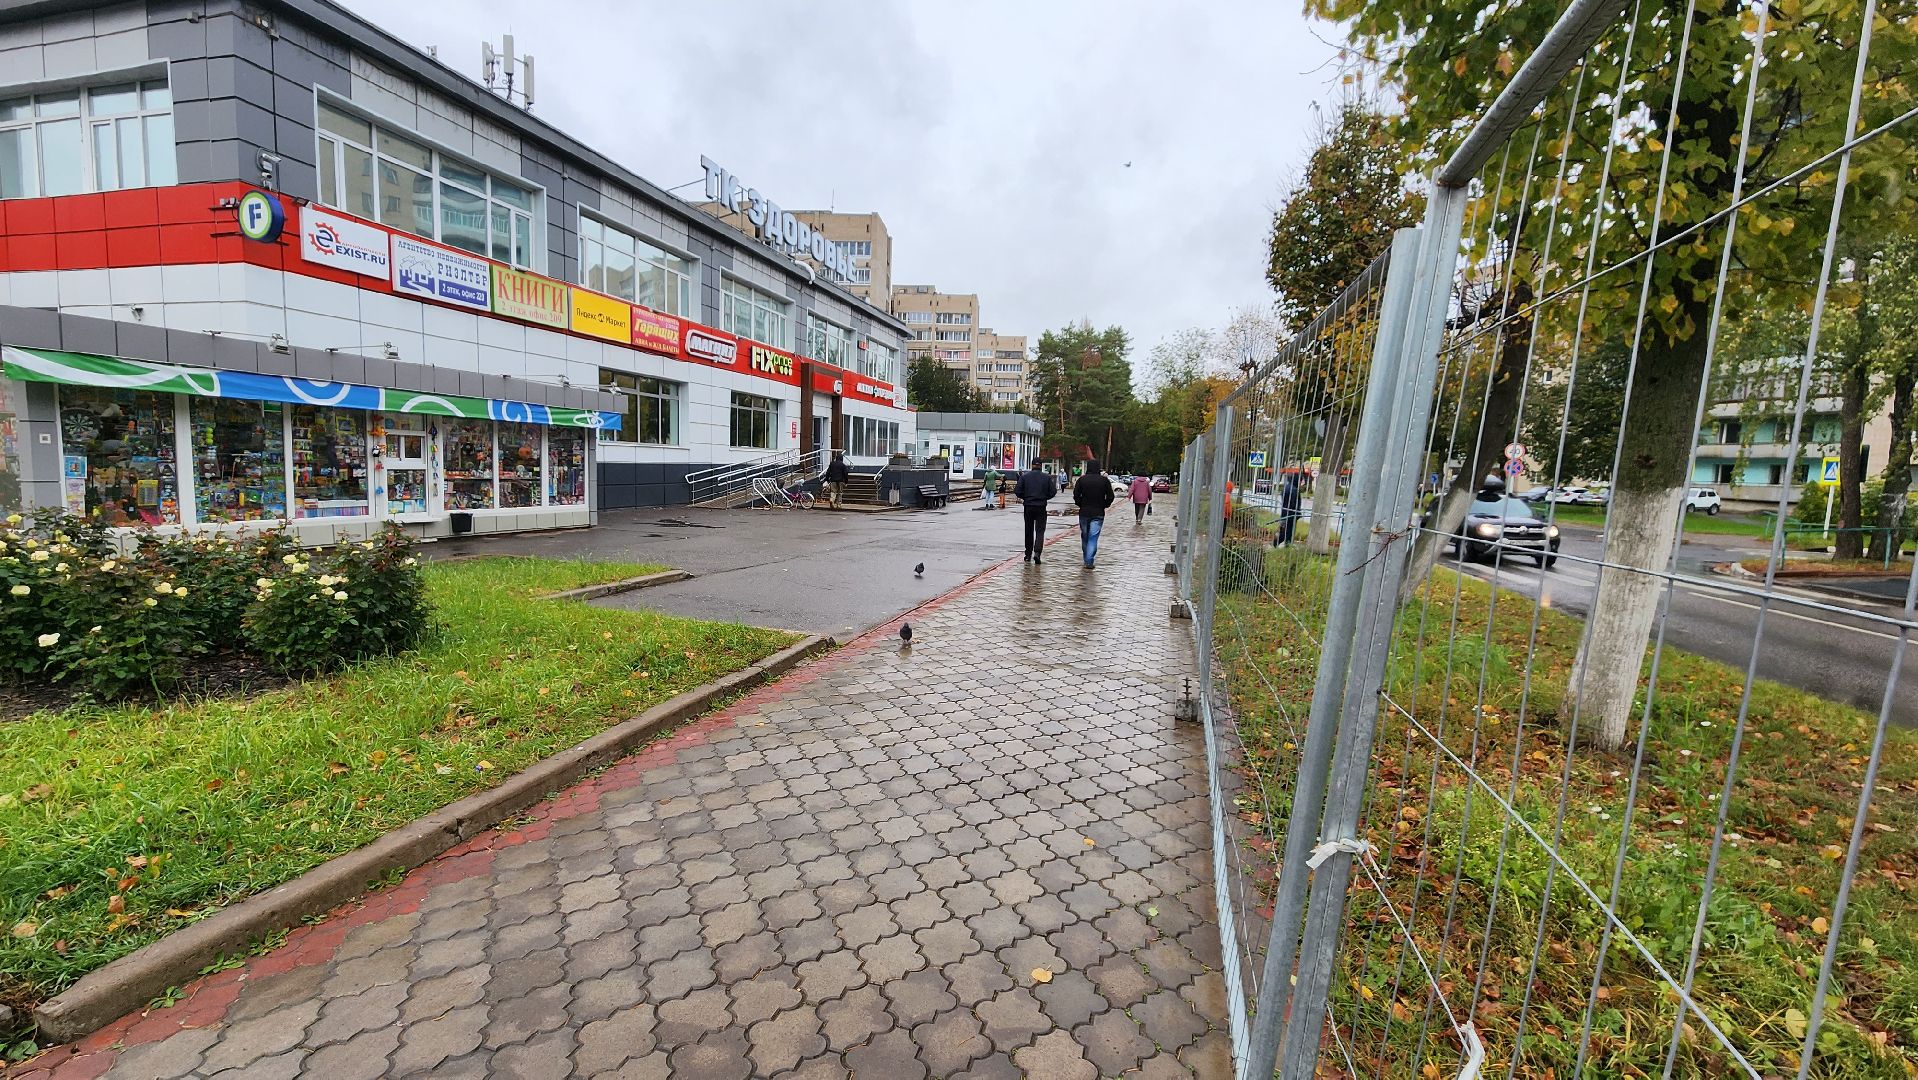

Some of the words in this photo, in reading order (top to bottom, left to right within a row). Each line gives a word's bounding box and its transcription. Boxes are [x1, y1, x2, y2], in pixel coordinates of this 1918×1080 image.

[249, 203, 262, 229] F
[701, 154, 739, 214] ТК
[748, 188, 857, 282] ЗДОРОВЬЕ
[335, 244, 386, 265] EXIST.RU
[398, 240, 435, 257] АГЕНТСТВО
[437, 251, 487, 272] НЕДВИЖИМОСТИ
[438, 262, 488, 286] РИЭЛТЕР
[442, 283, 446, 292] 2
[461, 289, 476, 300] офис
[497, 269, 564, 314] КНИГИ
[576, 307, 597, 320] Яндекс
[605, 315, 626, 328] Маркет
[752, 345, 775, 374] FIX
